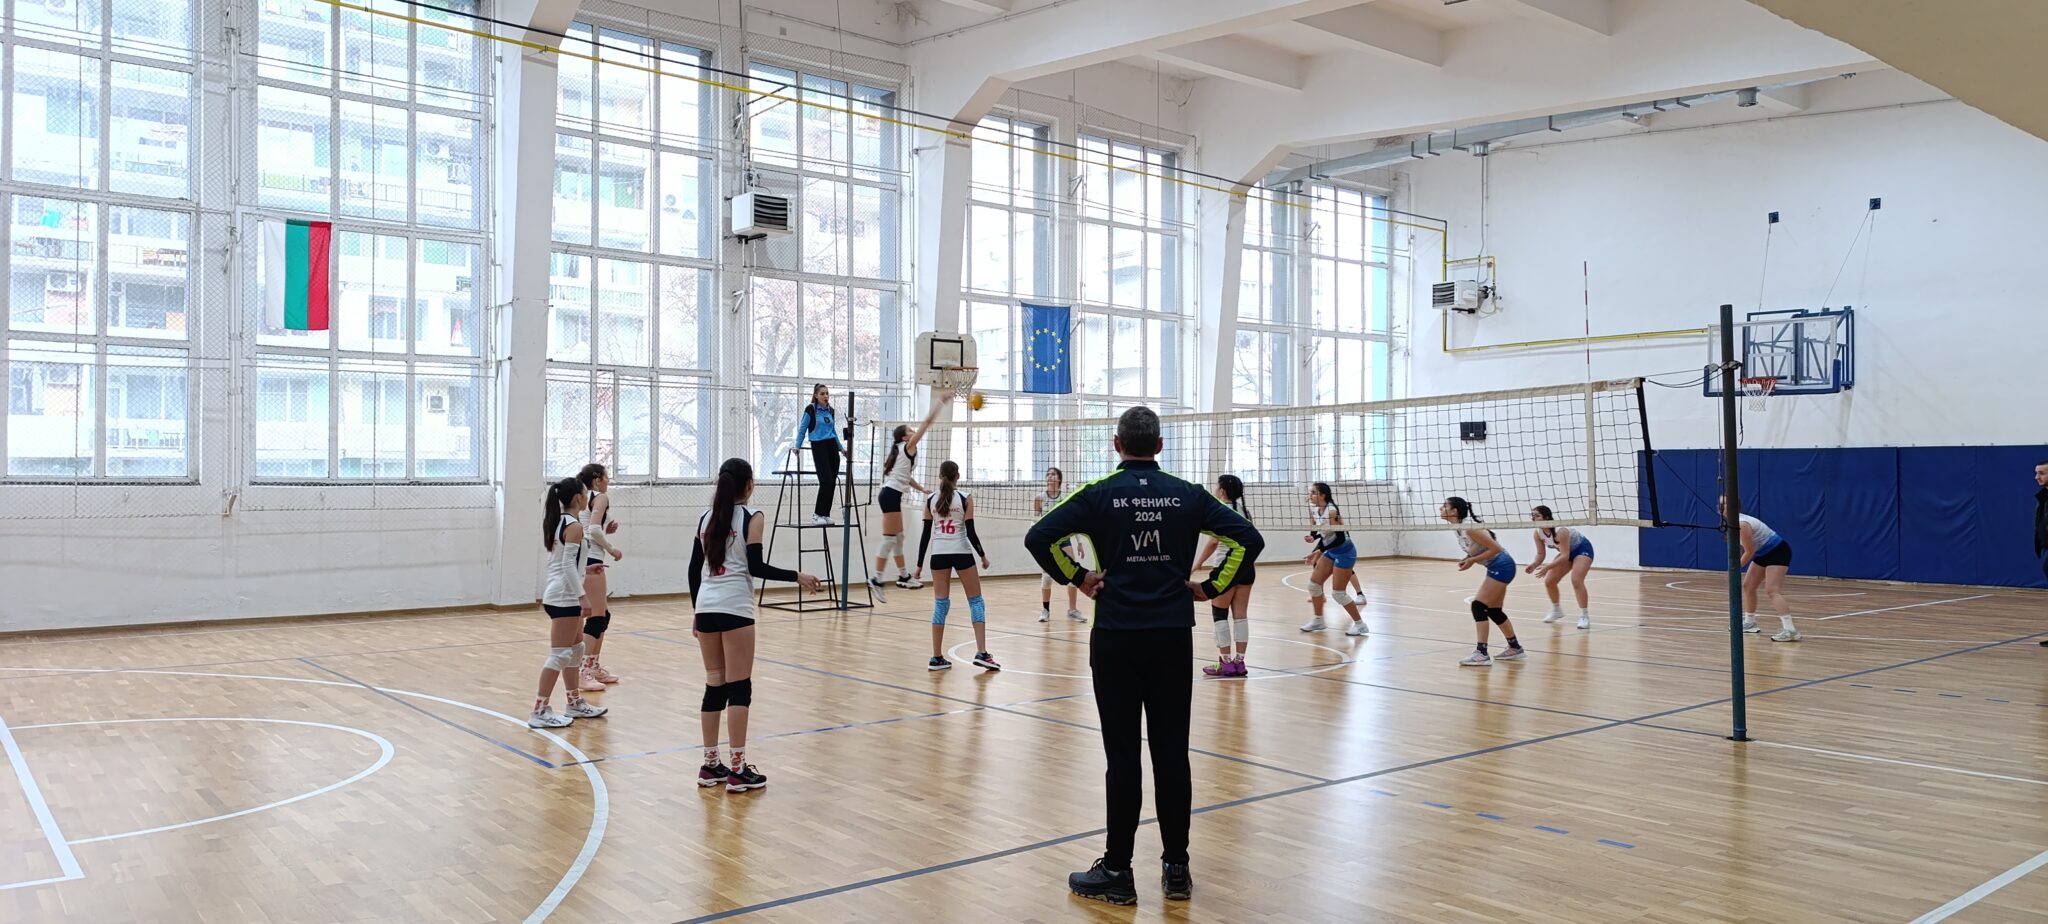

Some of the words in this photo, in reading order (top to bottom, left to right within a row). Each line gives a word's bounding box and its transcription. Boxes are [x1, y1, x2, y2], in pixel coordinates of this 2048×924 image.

[1113, 497, 1129, 508] ВК
[1131, 497, 1181, 508] ФЕНИКС
[1135, 511, 1162, 522] 2024
[939, 519, 956, 534] 16
[1130, 529, 1161, 554] VM
[1126, 555, 1159, 563] METAL-VM
